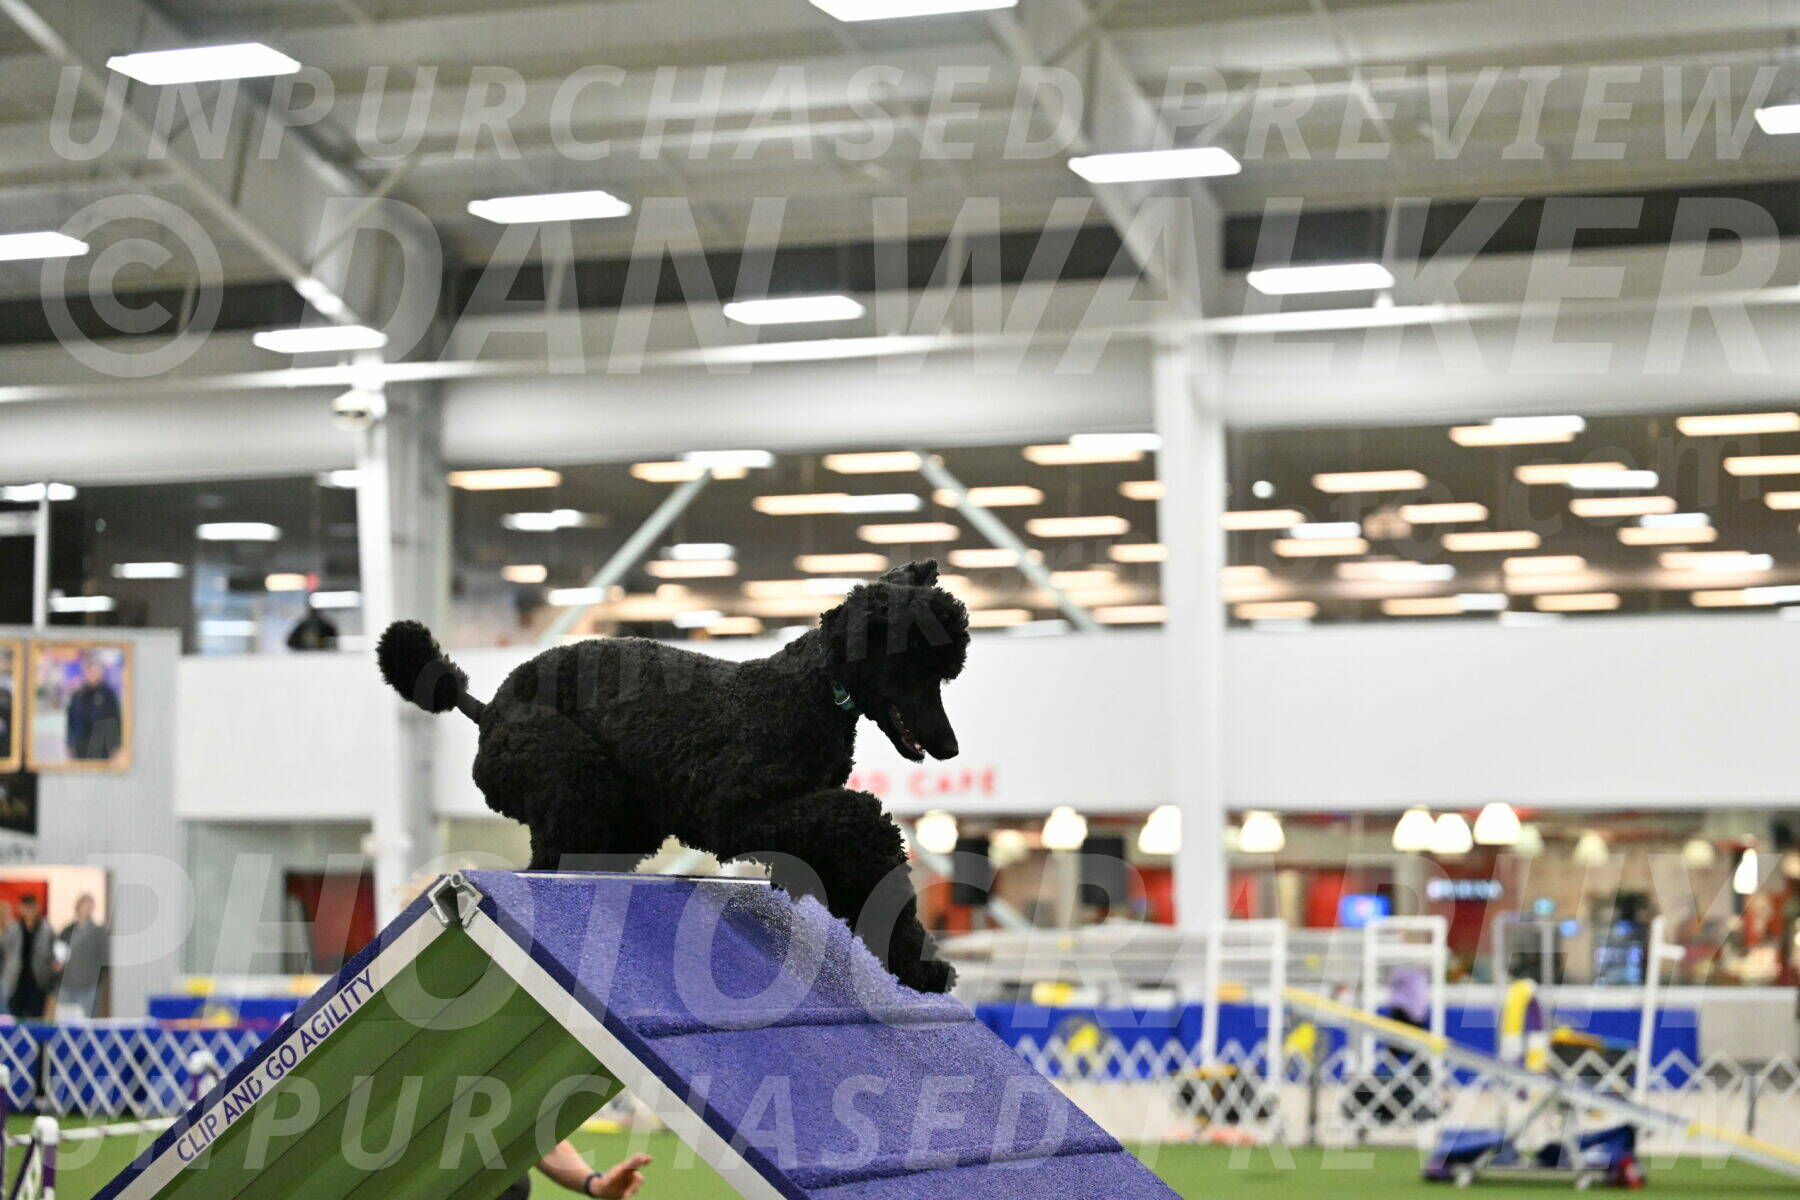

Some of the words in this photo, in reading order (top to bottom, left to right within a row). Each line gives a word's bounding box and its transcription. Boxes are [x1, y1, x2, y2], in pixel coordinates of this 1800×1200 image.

[176, 1113, 218, 1162] CLIP
[222, 1075, 264, 1125] AND
[265, 1043, 298, 1081] GO
[300, 968, 375, 1054] AGILITY
